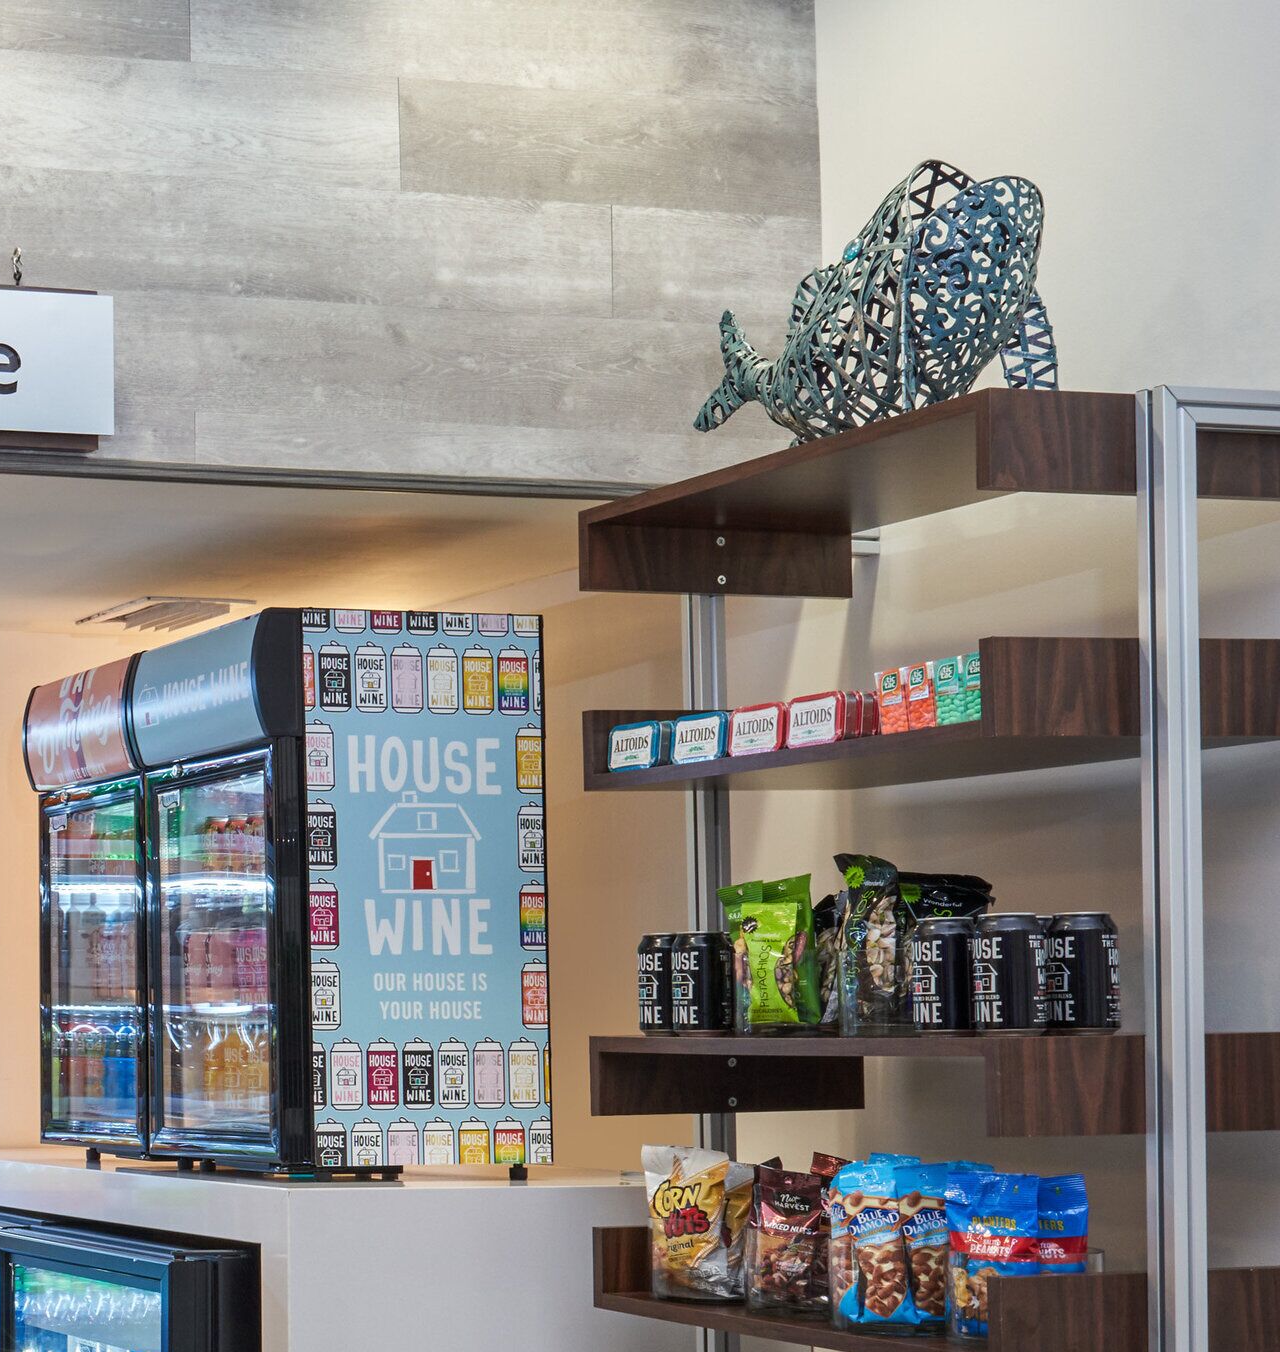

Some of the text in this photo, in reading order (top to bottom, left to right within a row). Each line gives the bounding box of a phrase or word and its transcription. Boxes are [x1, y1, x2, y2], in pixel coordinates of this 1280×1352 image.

[374, 614, 399, 627] WINE
[410, 615, 435, 628] WINE
[321, 657, 348, 670] HOUSE
[357, 658, 384, 671] HOUSE
[500, 660, 526, 673] HOUSE
[210, 660, 250, 705] WINE
[323, 692, 348, 705] WINE
[359, 693, 384, 705] WINE
[501, 696, 526, 709] WINE
[792, 708, 834, 728] ALTOIDS
[735, 718, 775, 737] ALTOIDS
[678, 727, 717, 745] ALTOIDS
[613, 736, 649, 754] ALTOIDS
[347, 734, 502, 795] HOUSE
[364, 898, 493, 956] WINE
[373, 973, 487, 992] OUR HOUSE IS
[759, 942, 772, 1008] PISTACHIOS
[380, 1001, 482, 1020] YOUR HOUSE
[369, 1054, 396, 1067] HOUSE
[370, 1089, 396, 1102] WINE
[317, 1135, 345, 1148] HOUSE
[496, 1133, 523, 1145] HOUSE
[655, 1180, 702, 1219] CORN
[774, 1200, 811, 1212] HARVEST
[849, 1211, 899, 1236] DIAMOND
[857, 1209, 883, 1225] BLUE
[972, 1215, 1017, 1232] PLANTERS
